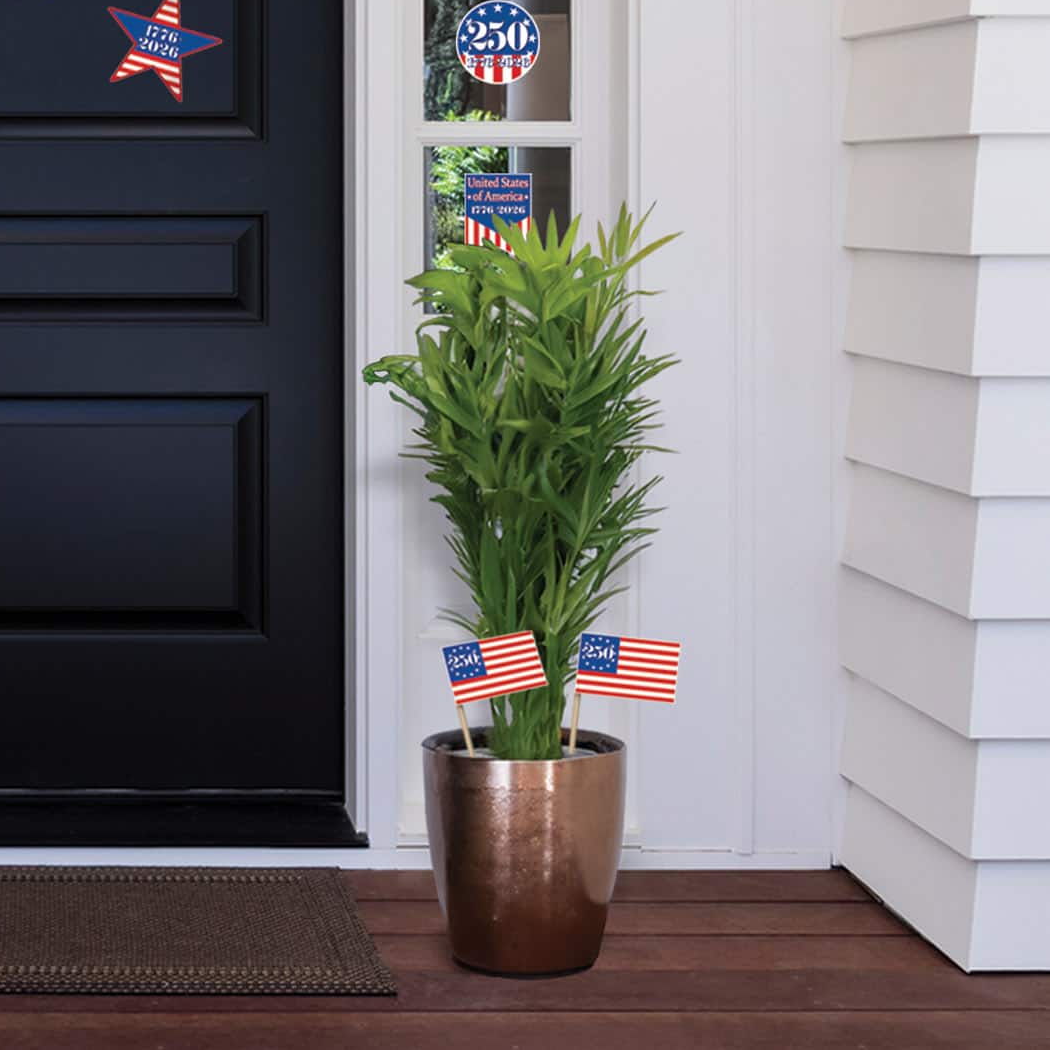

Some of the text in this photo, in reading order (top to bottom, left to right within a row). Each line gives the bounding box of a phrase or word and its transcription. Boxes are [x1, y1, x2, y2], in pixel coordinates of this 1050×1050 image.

[467, 20, 528, 51] 250
[139, 37, 180, 58] 2026
[467, 176, 529, 188] United States
[484, 189, 524, 202] America
[450, 652, 478, 668] 250
[584, 644, 614, 660] 250
